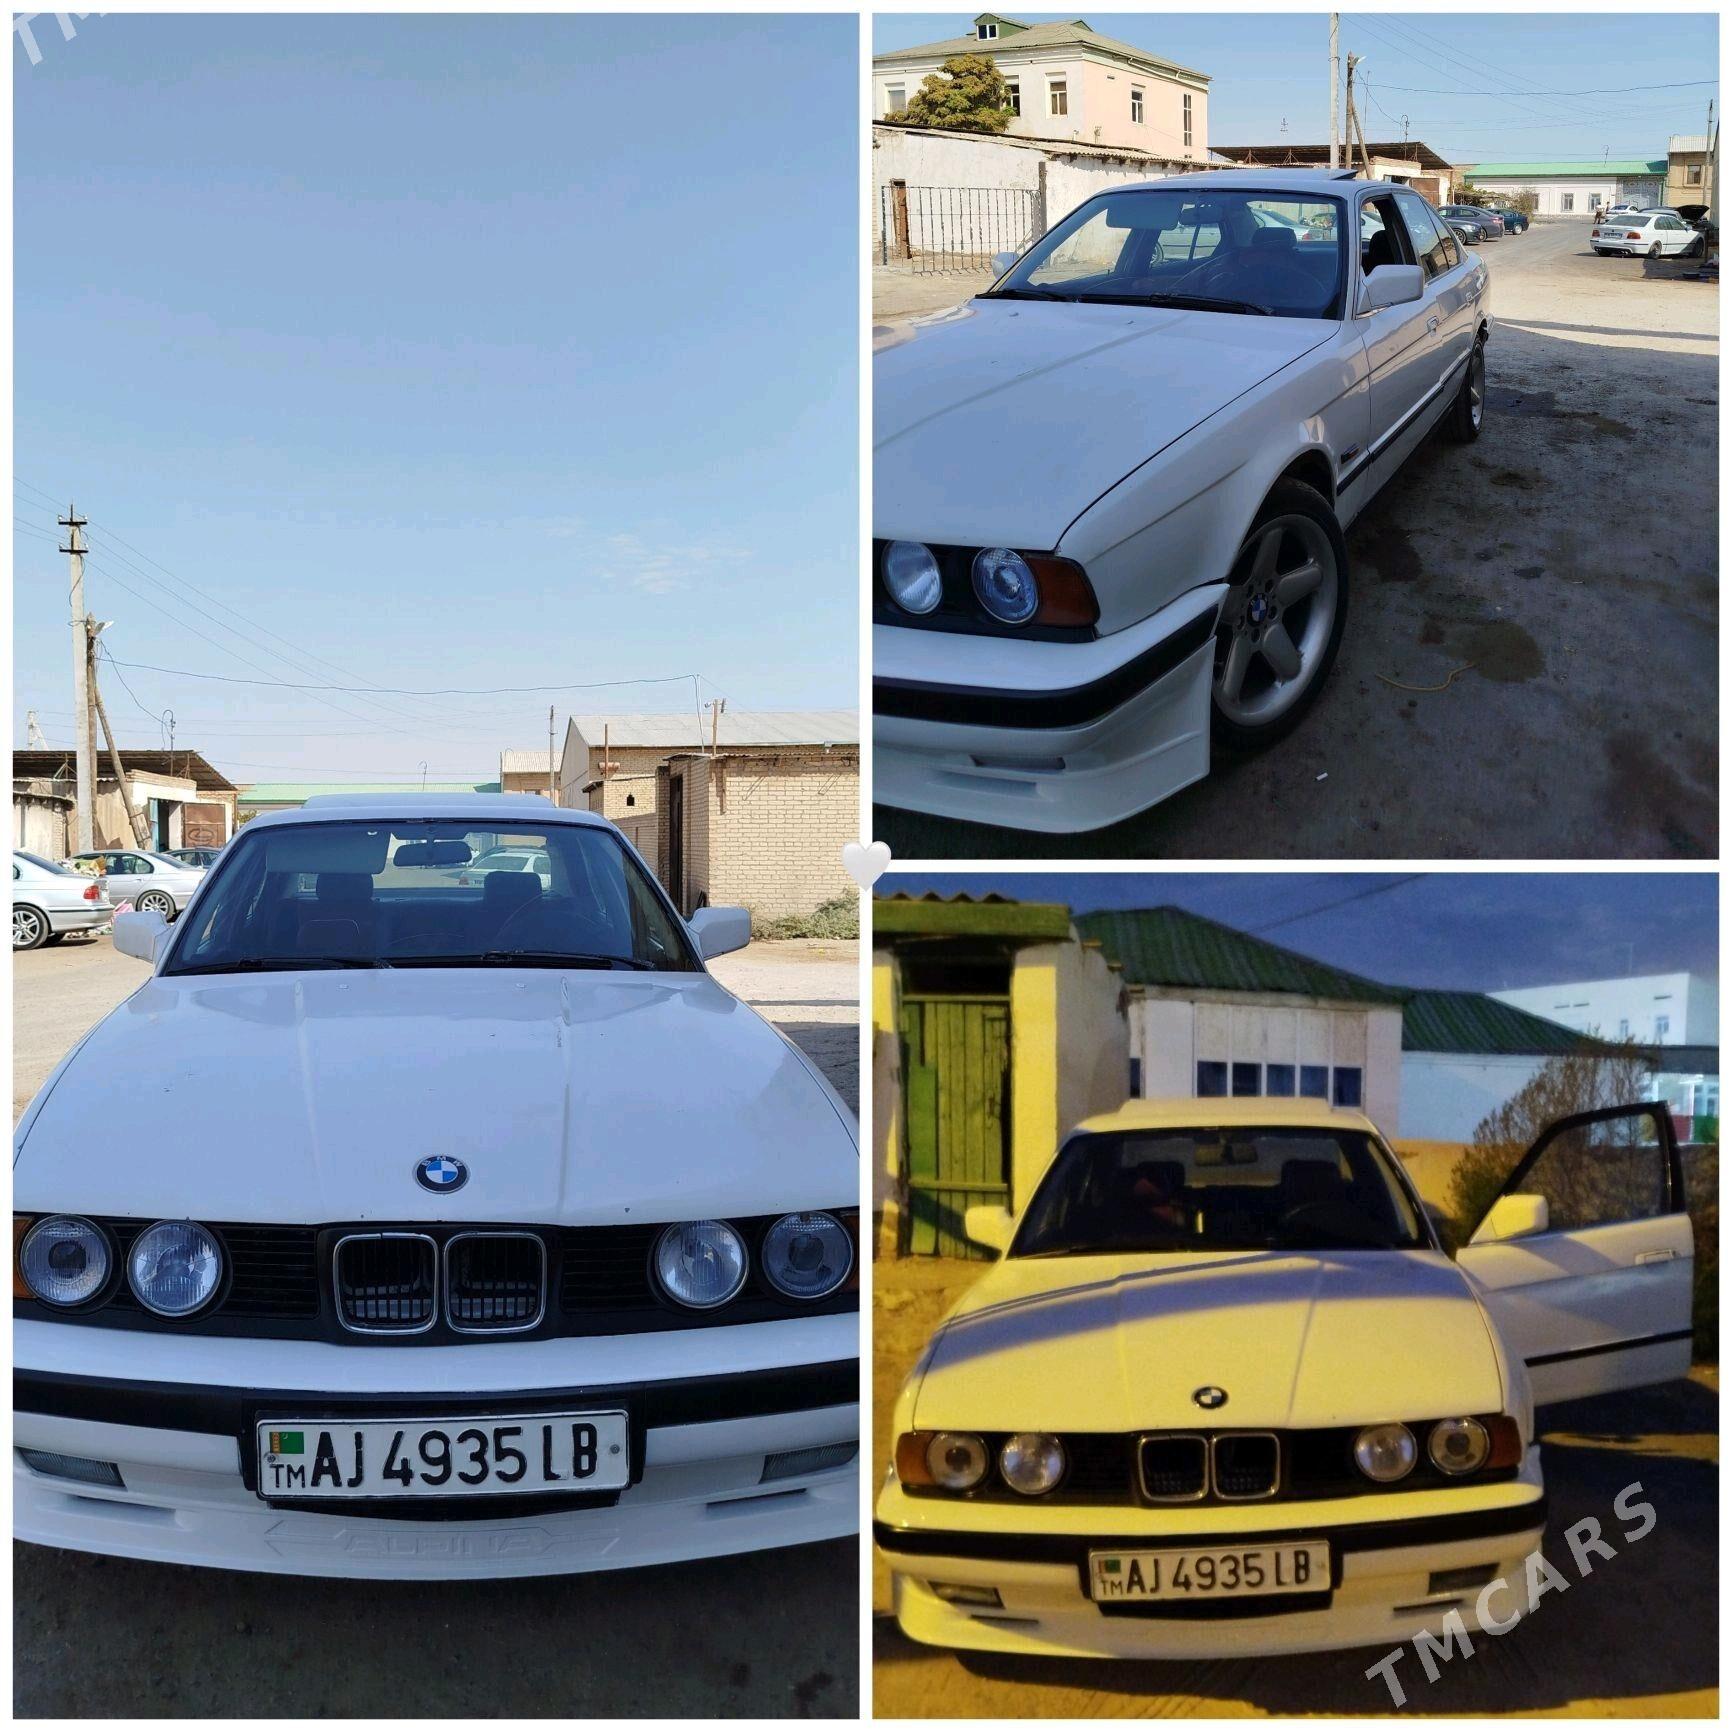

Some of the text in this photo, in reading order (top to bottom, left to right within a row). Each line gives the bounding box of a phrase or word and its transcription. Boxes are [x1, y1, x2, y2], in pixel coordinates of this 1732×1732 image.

[421, 1156, 463, 1167] BMW
[310, 1422, 598, 1488] AJ 4935 LB
[269, 1463, 306, 1488] TM
[1126, 1549, 1311, 1594] AJ 4935 LB
[1102, 1579, 1124, 1596] TM
